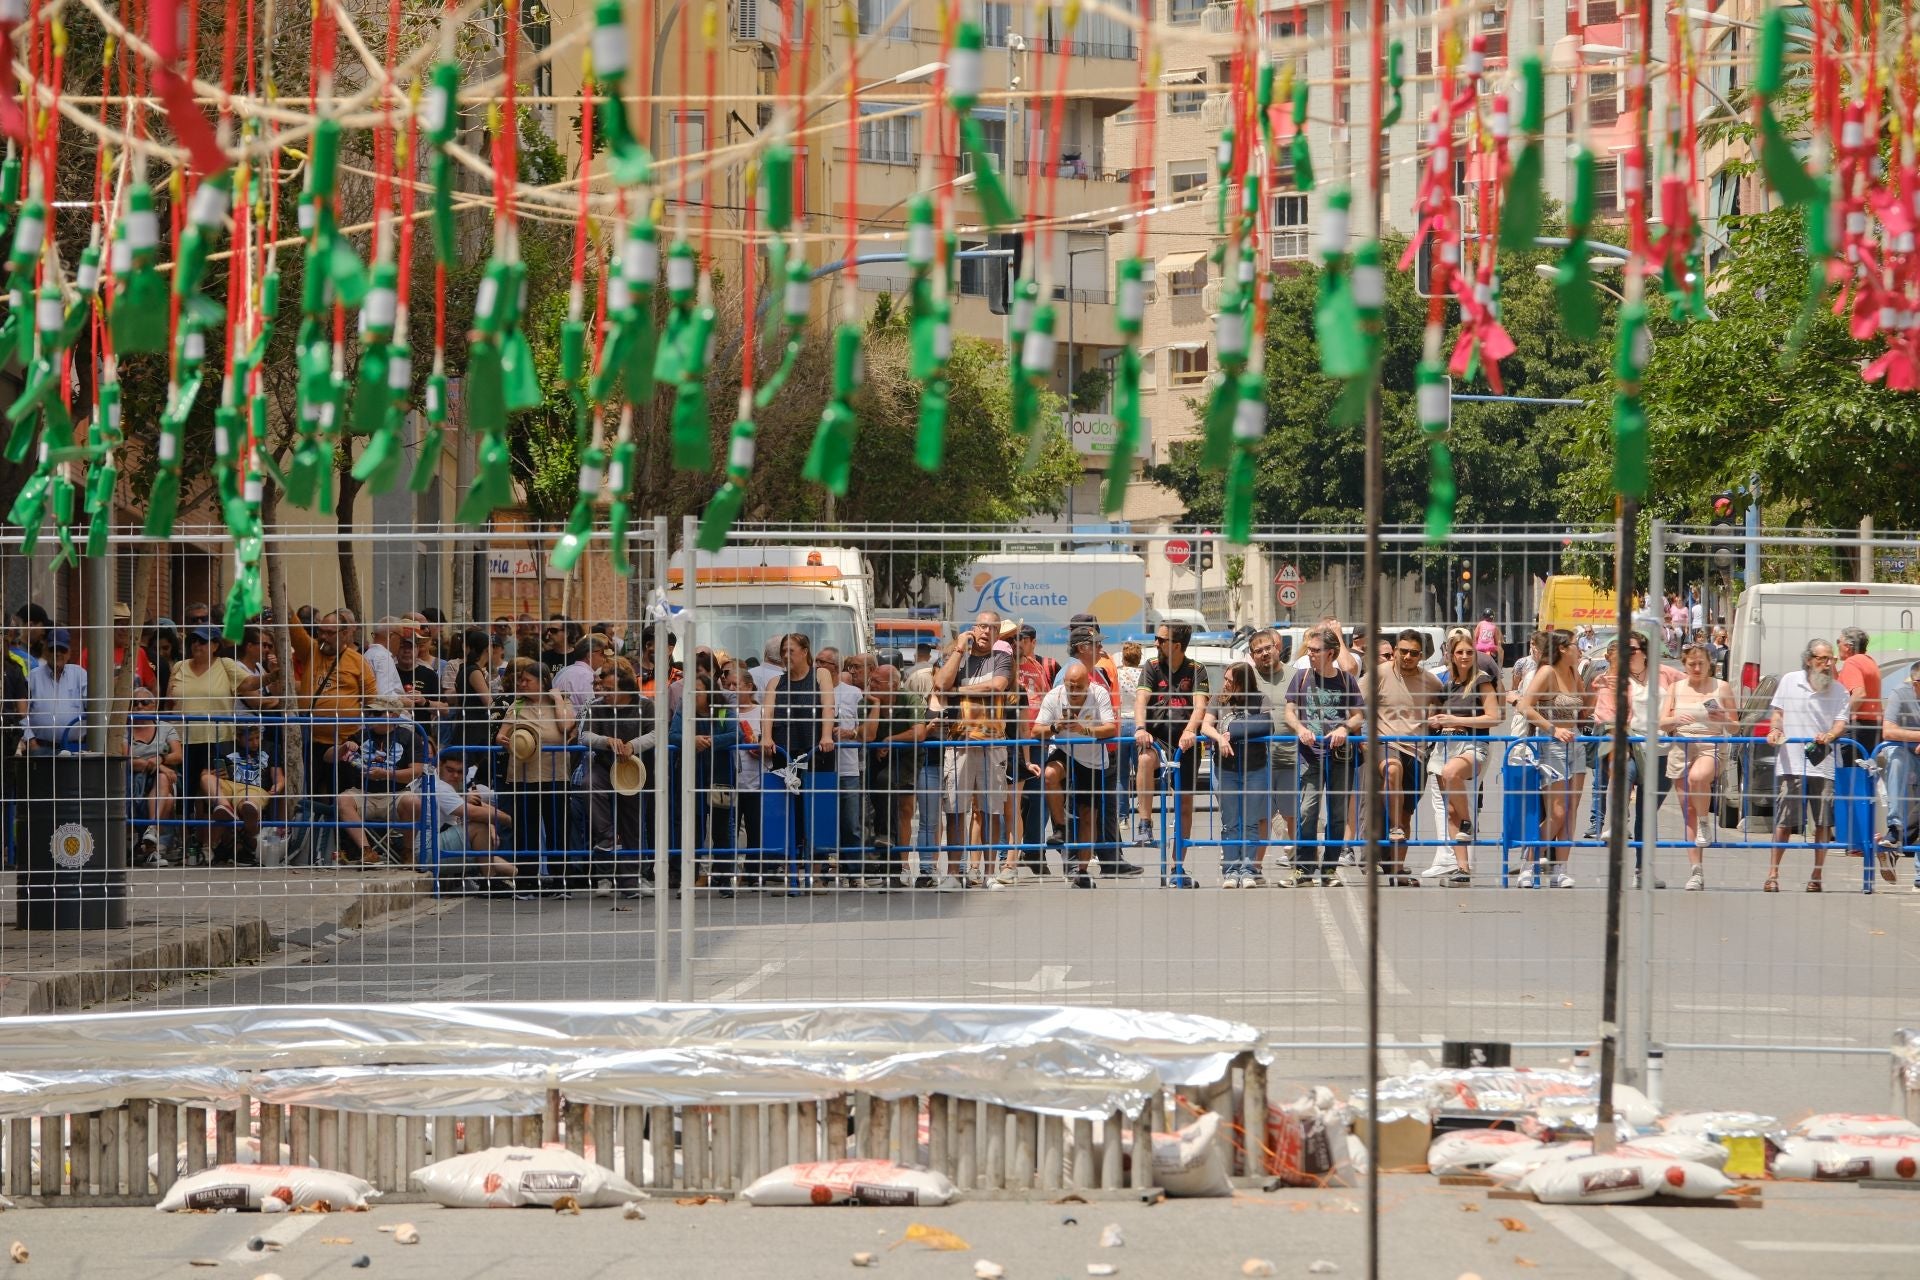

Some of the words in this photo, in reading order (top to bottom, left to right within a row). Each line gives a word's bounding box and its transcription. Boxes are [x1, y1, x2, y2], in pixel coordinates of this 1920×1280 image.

[1167, 546, 1189, 555] STOP
[1023, 581, 1050, 590] haces
[1282, 591, 1296, 600] 40
[1571, 608, 1616, 619] DHL
